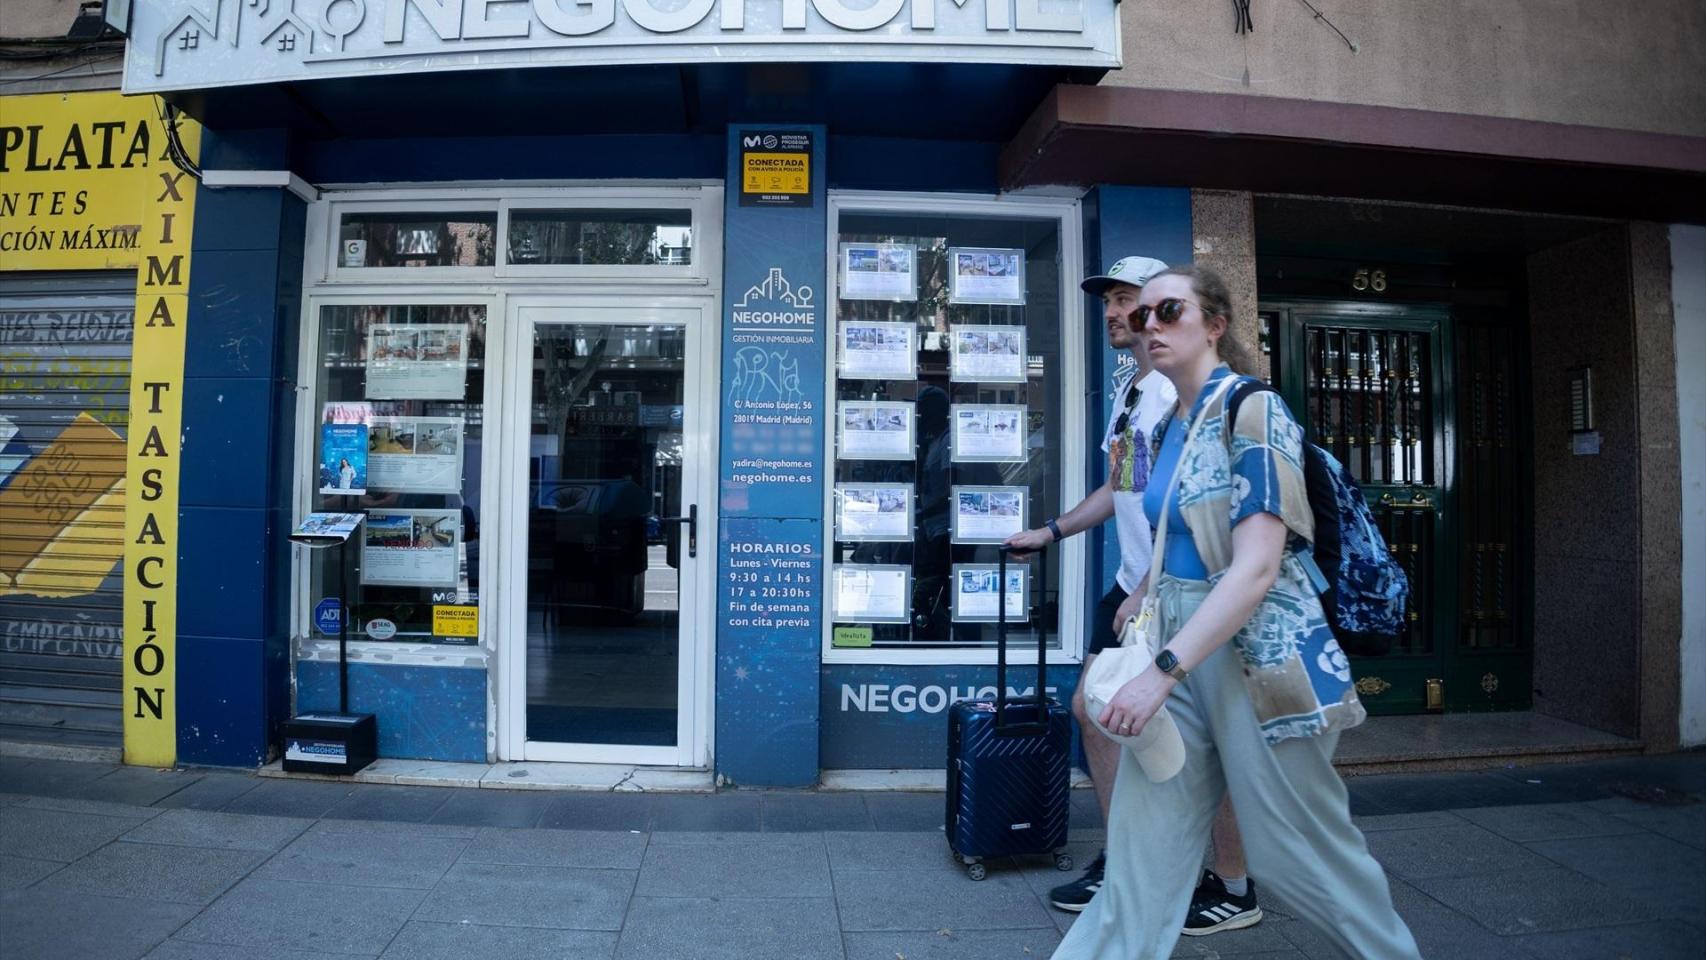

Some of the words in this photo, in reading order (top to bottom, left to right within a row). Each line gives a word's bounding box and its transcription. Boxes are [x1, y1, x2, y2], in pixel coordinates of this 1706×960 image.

[59, 224, 141, 249] MÁXIM
[1352, 269, 1387, 292] 56
[733, 311, 815, 324] NEGOHOME
[732, 334, 764, 343] GESTIÓN
[766, 335, 814, 344] INMOBILIARIA
[745, 401, 775, 409] Antonio
[733, 415, 755, 423] 28019
[756, 415, 780, 423] Madrid
[782, 416, 813, 424] (Madrid)
[732, 459, 812, 469] yadira@negohome.es
[733, 473, 812, 484] negohome.es
[133, 382, 170, 720] TASACIÓN
[730, 543, 812, 554] HORARIOS
[730, 558, 760, 568] Lunes
[771, 558, 811, 568] Viernes
[729, 572, 758, 582] 9:30
[778, 573, 791, 583] 14
[797, 573, 811, 583] hs
[731, 587, 744, 597] 17
[762, 587, 811, 597] 20:30hs
[729, 602, 746, 611] Fin
[750, 602, 764, 611] de
[767, 604, 810, 612] semana
[729, 618, 748, 626] con
[752, 617, 772, 626] cita
[776, 617, 810, 629] previa
